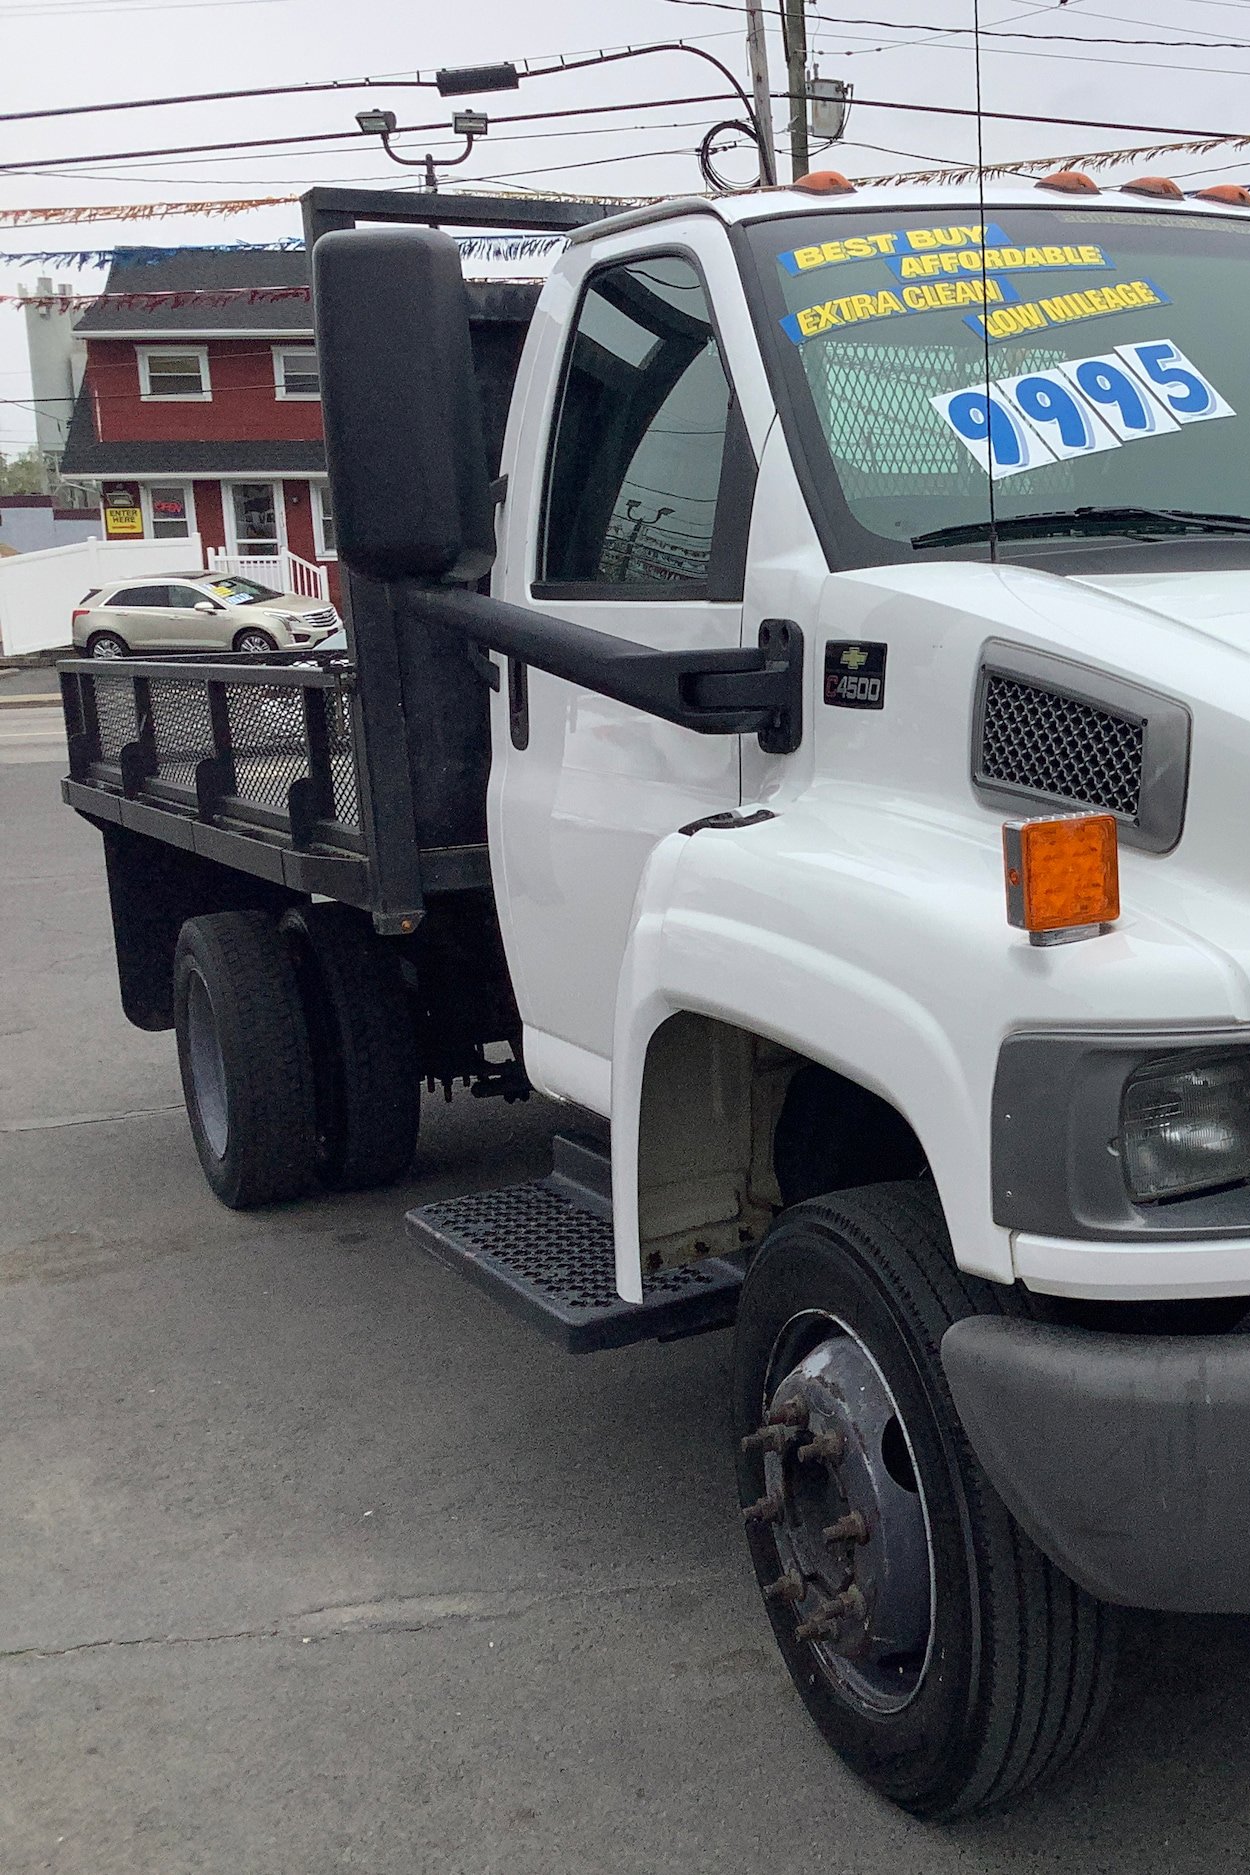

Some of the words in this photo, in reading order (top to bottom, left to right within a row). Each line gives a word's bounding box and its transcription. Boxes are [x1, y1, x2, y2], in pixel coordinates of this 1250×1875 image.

[794, 233, 899, 270] BEST
[905, 225, 988, 250] BUY
[900, 245, 1105, 279] AFFORDABLE
[797, 290, 907, 337] EXTRA
[902, 278, 1004, 310] CLEAN
[977, 302, 1049, 339] LOW
[1039, 281, 1162, 322] MILEAGE
[948, 344, 1218, 468] 9995
[825, 675, 881, 701] C4500
